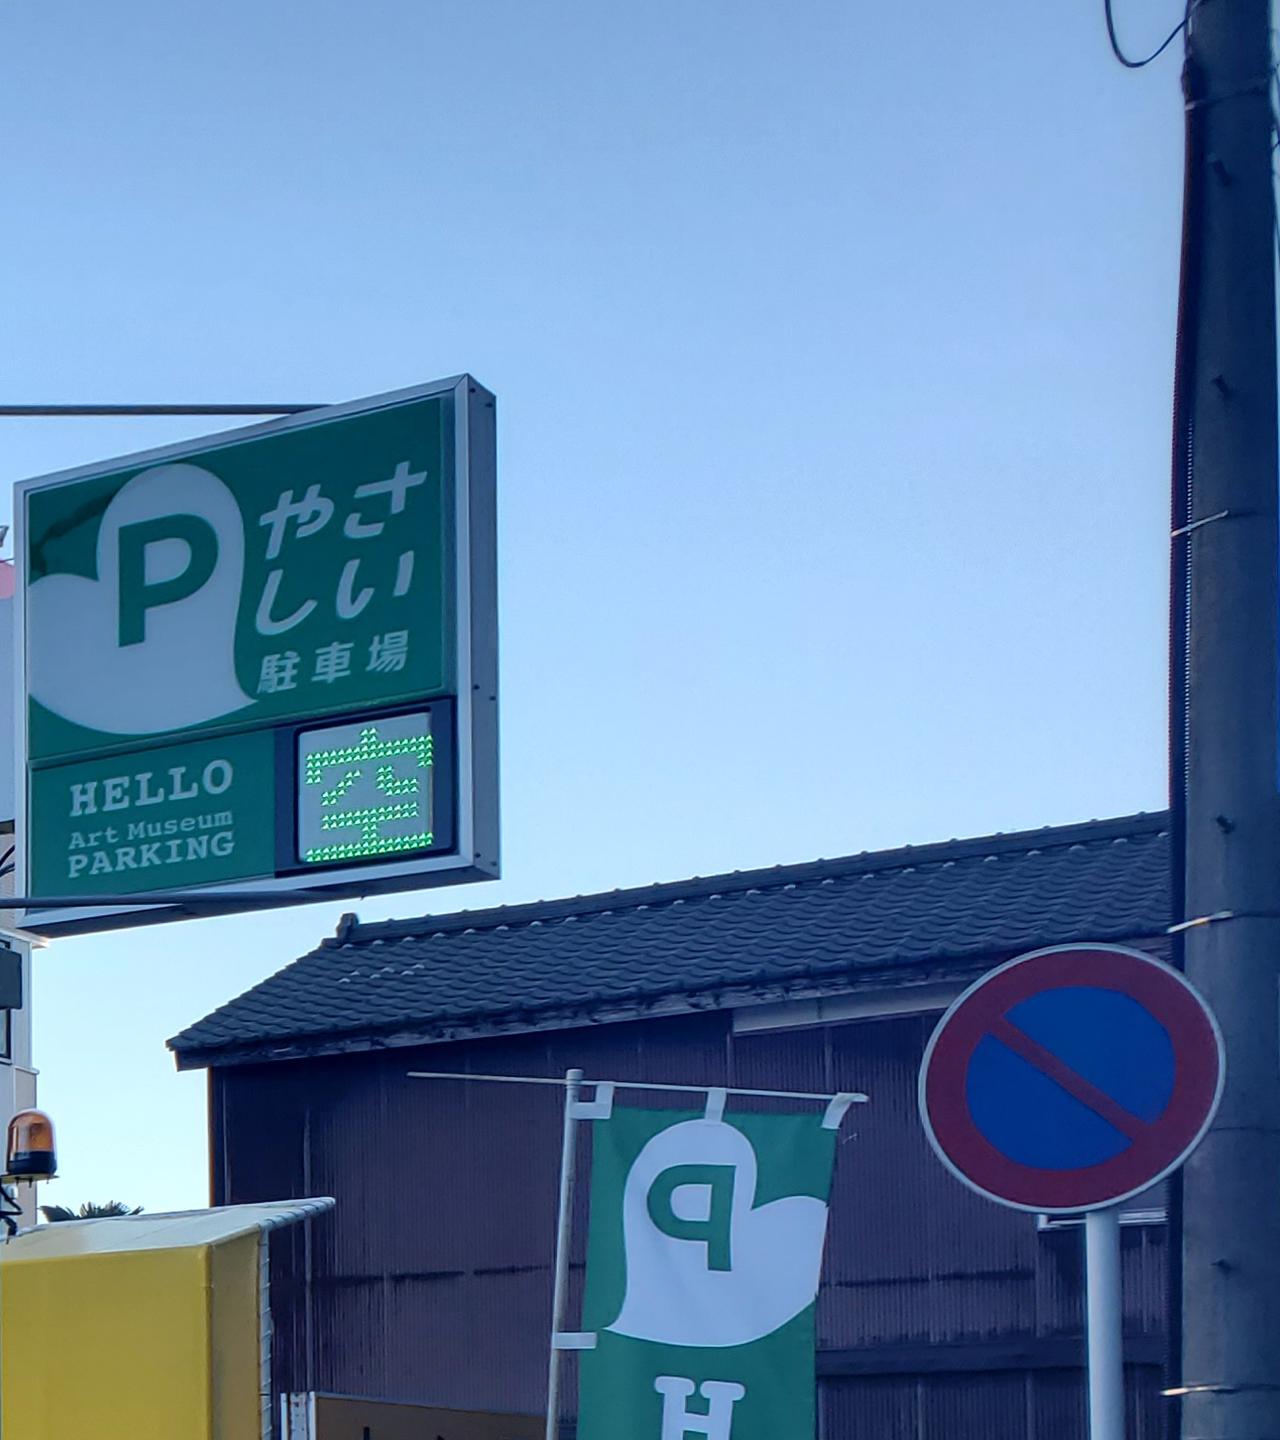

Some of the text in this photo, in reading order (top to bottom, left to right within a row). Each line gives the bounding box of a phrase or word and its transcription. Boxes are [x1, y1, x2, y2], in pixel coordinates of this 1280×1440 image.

[117, 513, 220, 648] P
[256, 630, 410, 695] 駐車場
[69, 759, 235, 818] HELLO
[305, 727, 433, 863] 空
[68, 810, 235, 850] Art Museum
[68, 830, 237, 879] PARKING
